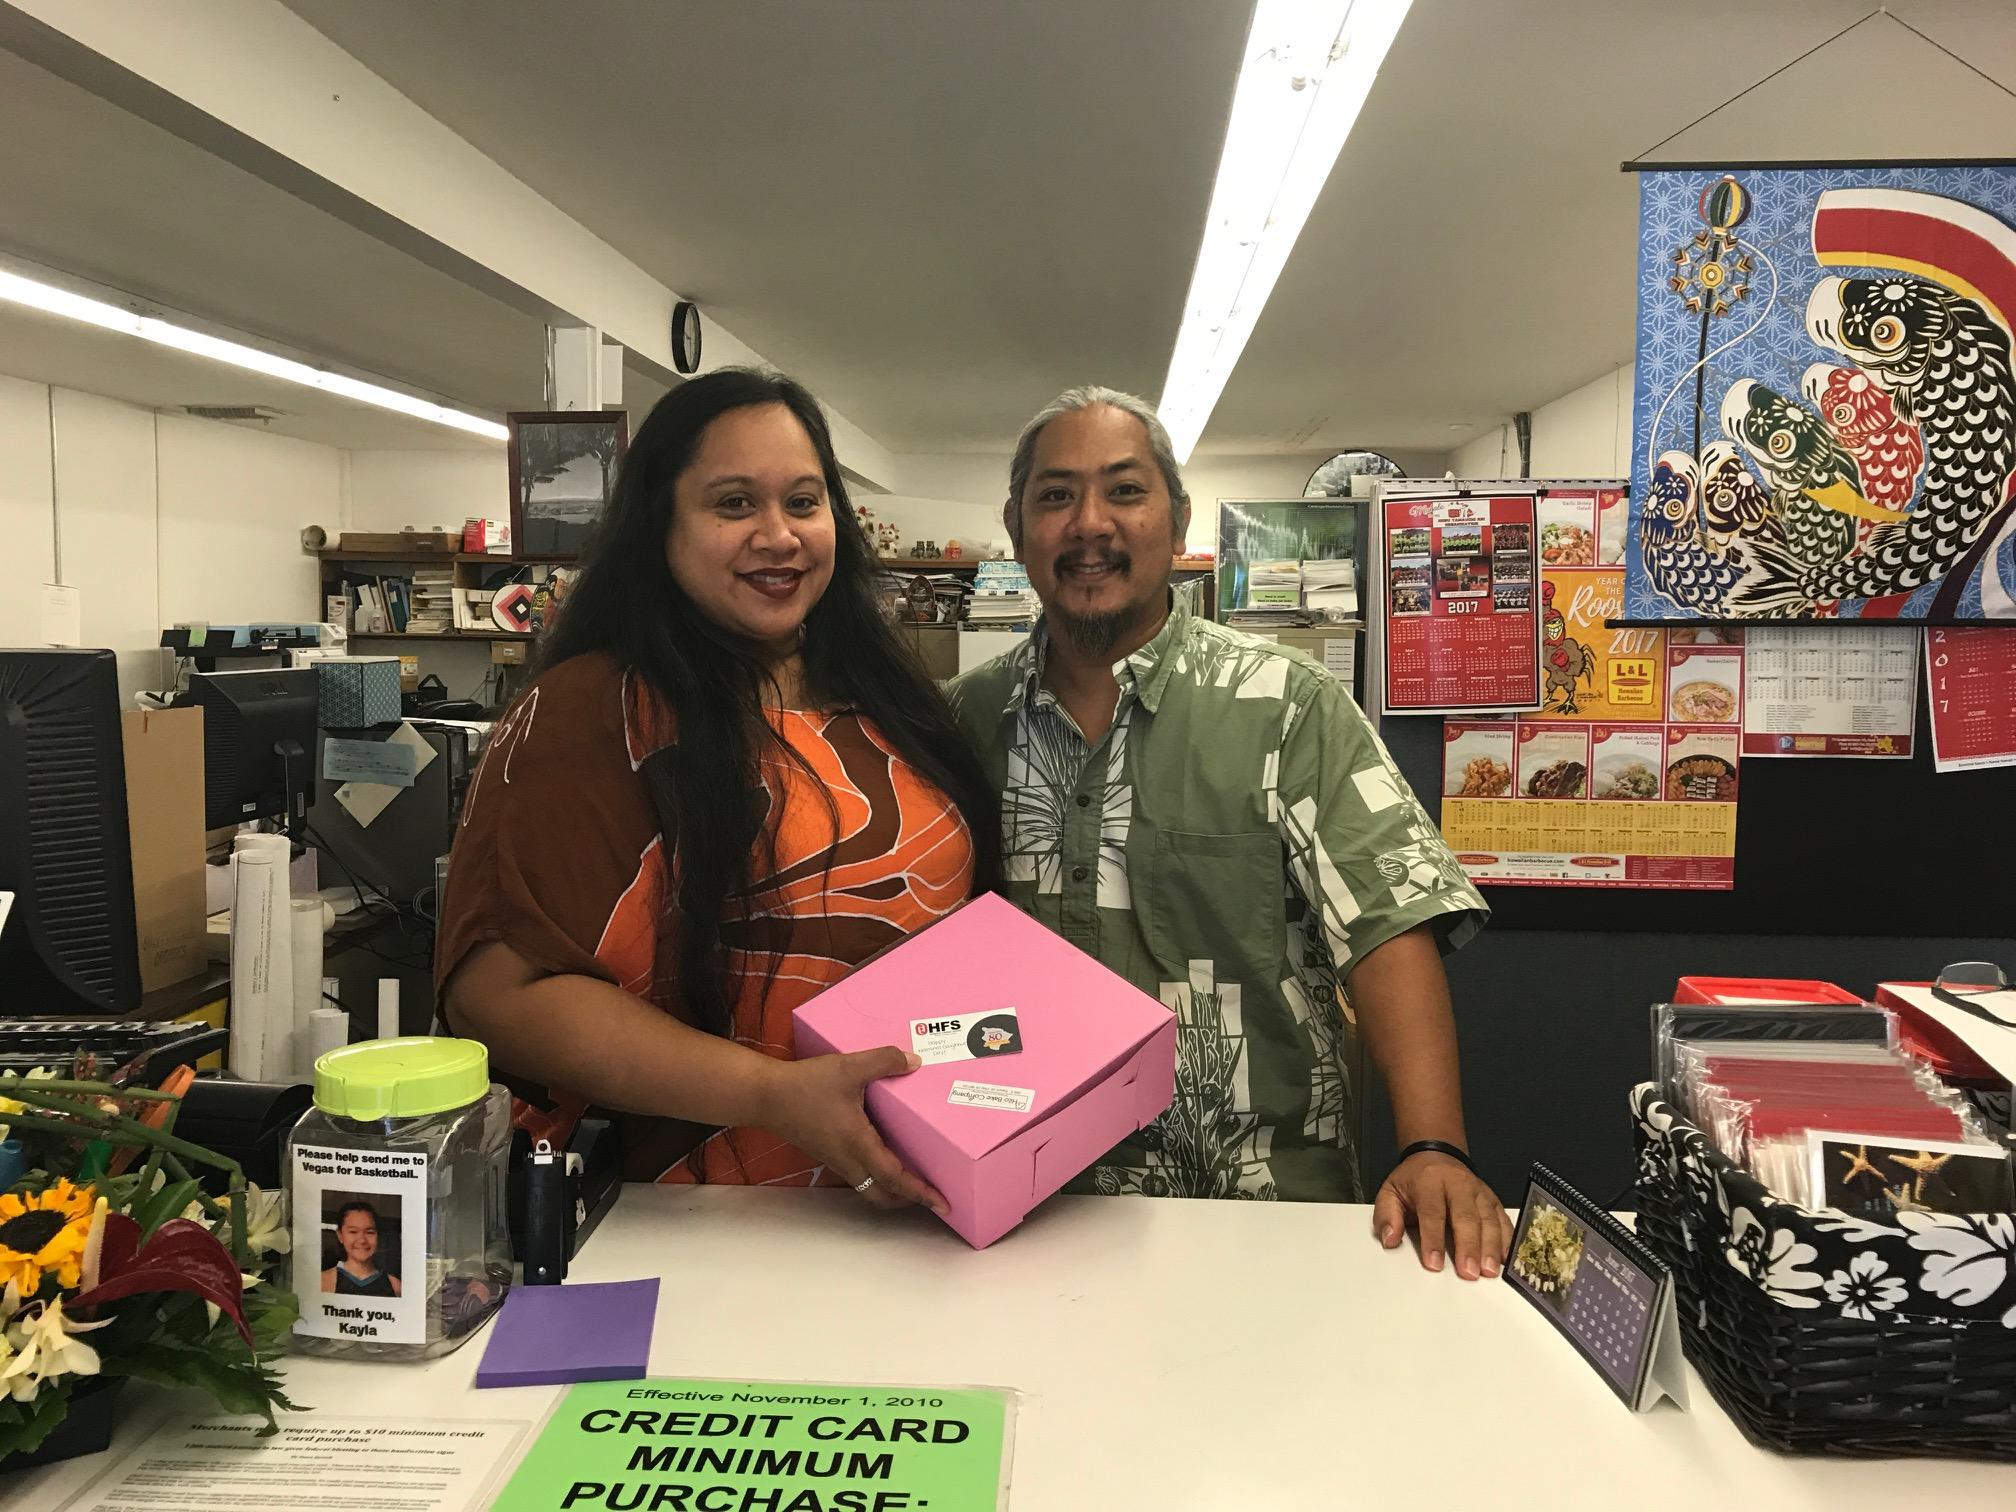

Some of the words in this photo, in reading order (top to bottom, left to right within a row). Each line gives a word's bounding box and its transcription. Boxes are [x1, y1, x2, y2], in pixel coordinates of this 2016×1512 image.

[1448, 601, 1478, 614] 2017
[1608, 630, 1659, 655] 2017
[928, 1020, 962, 1033] HFS
[298, 1148, 332, 1160] Please
[336, 1152, 358, 1163] help
[362, 1155, 389, 1164] send
[392, 1157, 410, 1165] me
[413, 1156, 424, 1166] to
[302, 1162, 334, 1174] Vegas
[337, 1164, 352, 1175] for
[322, 1304, 364, 1319] Thank
[366, 1308, 396, 1322] you,
[339, 1322, 378, 1338] Kayla
[626, 1388, 724, 1403] Effective
[731, 1391, 850, 1406] November
[860, 1396, 876, 1409] 1,
[886, 1396, 944, 1408] 2010
[191, 1424, 252, 1432] Merchants
[580, 1409, 793, 1439] CREDIT
[806, 1416, 970, 1444] CARD
[626, 1446, 894, 1480] MINIMUM
